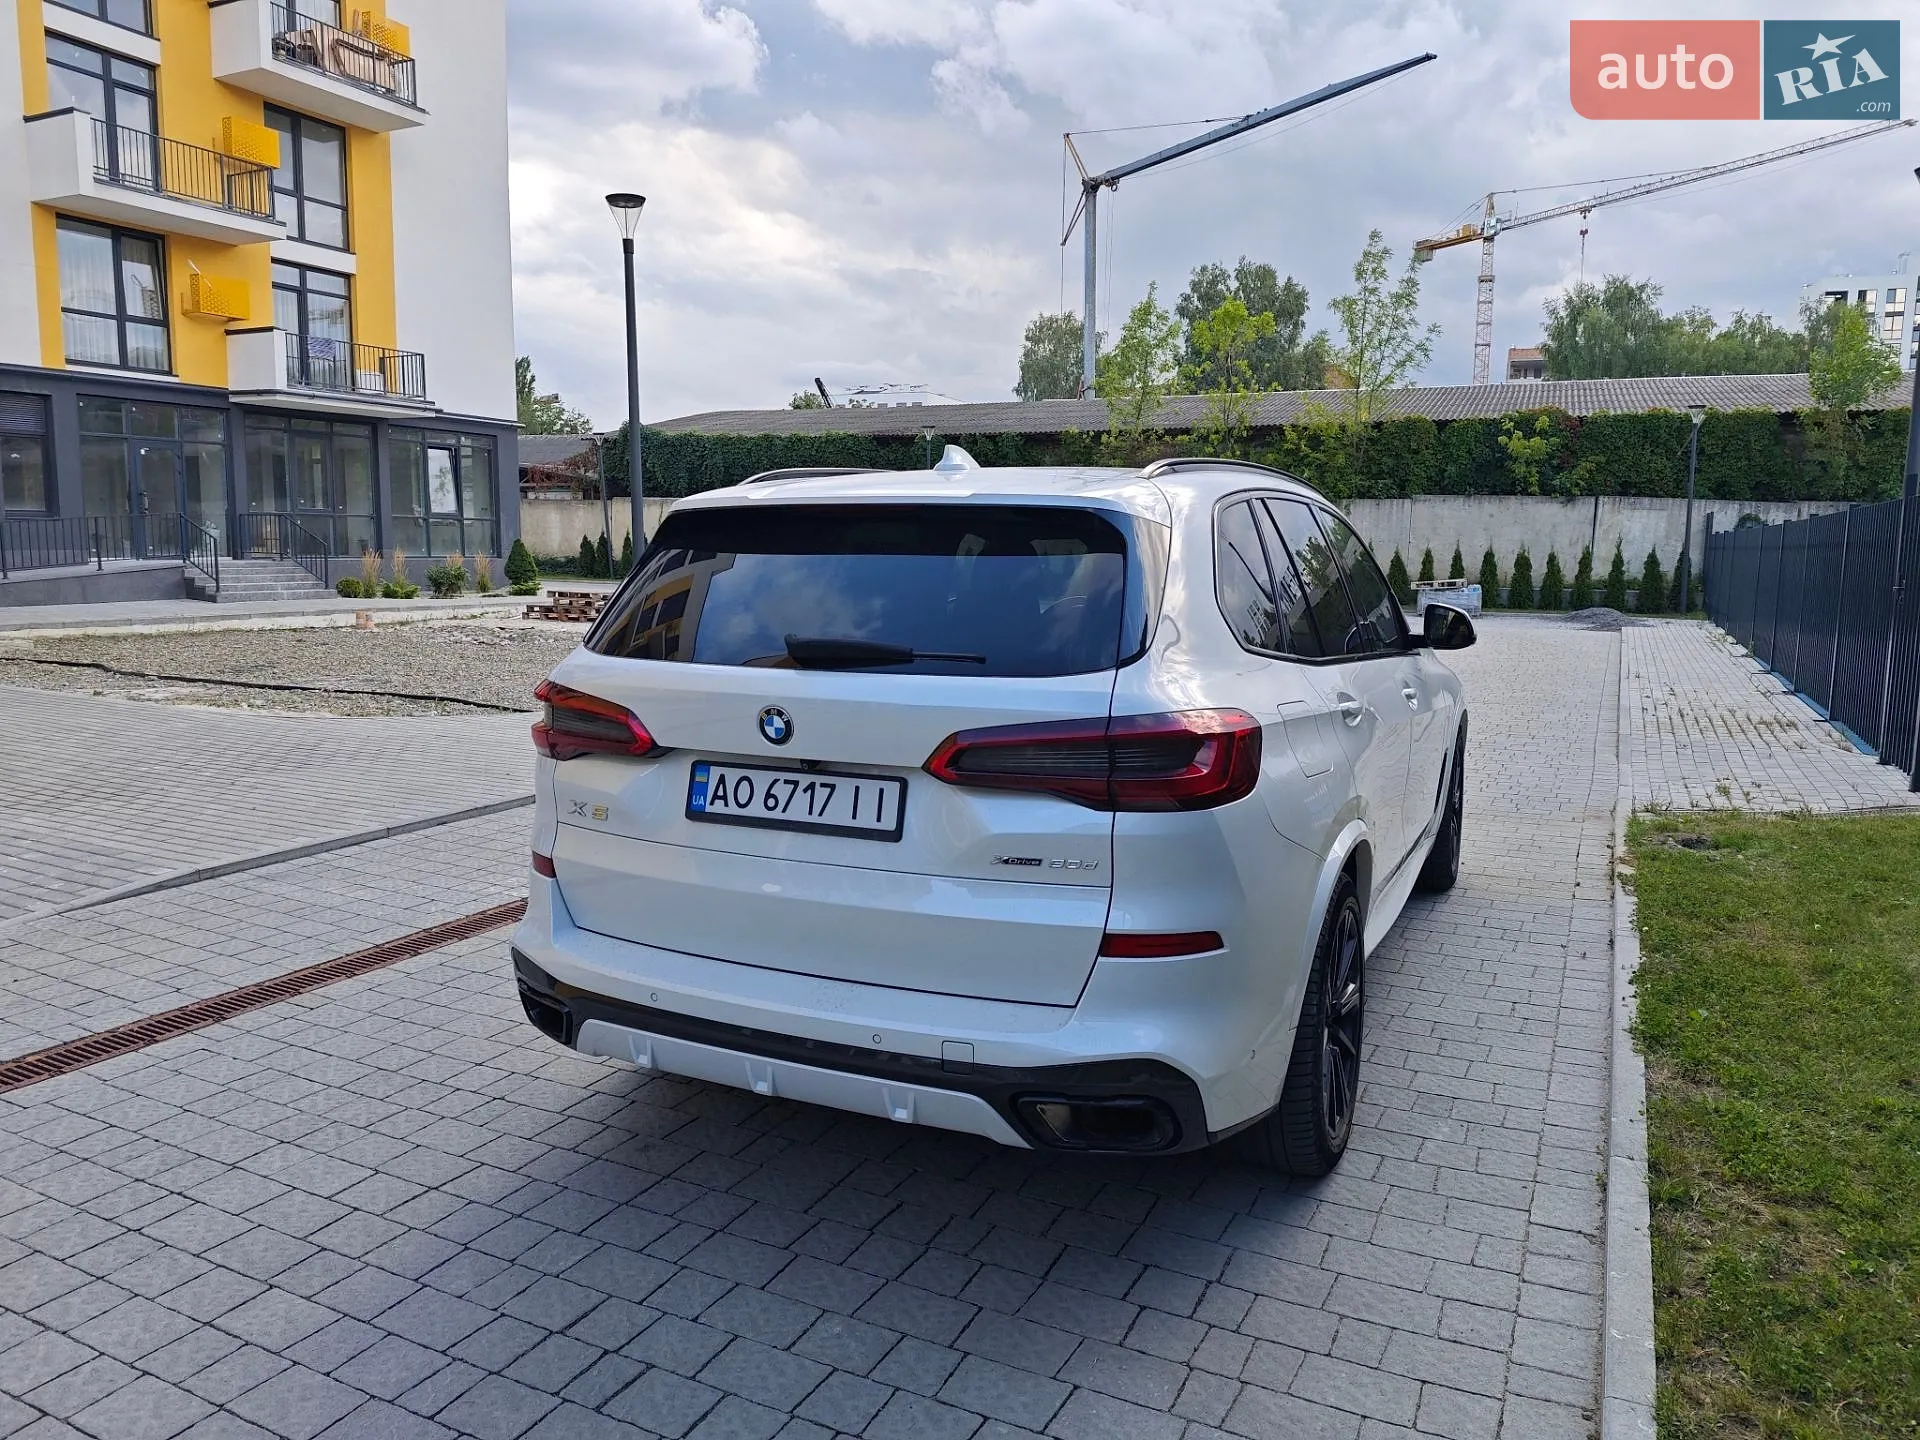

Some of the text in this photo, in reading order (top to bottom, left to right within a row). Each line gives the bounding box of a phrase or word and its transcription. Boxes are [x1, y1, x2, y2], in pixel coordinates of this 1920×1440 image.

[692, 794, 704, 806] UA
[709, 773, 755, 809] AO
[763, 778, 836, 817] 6717
